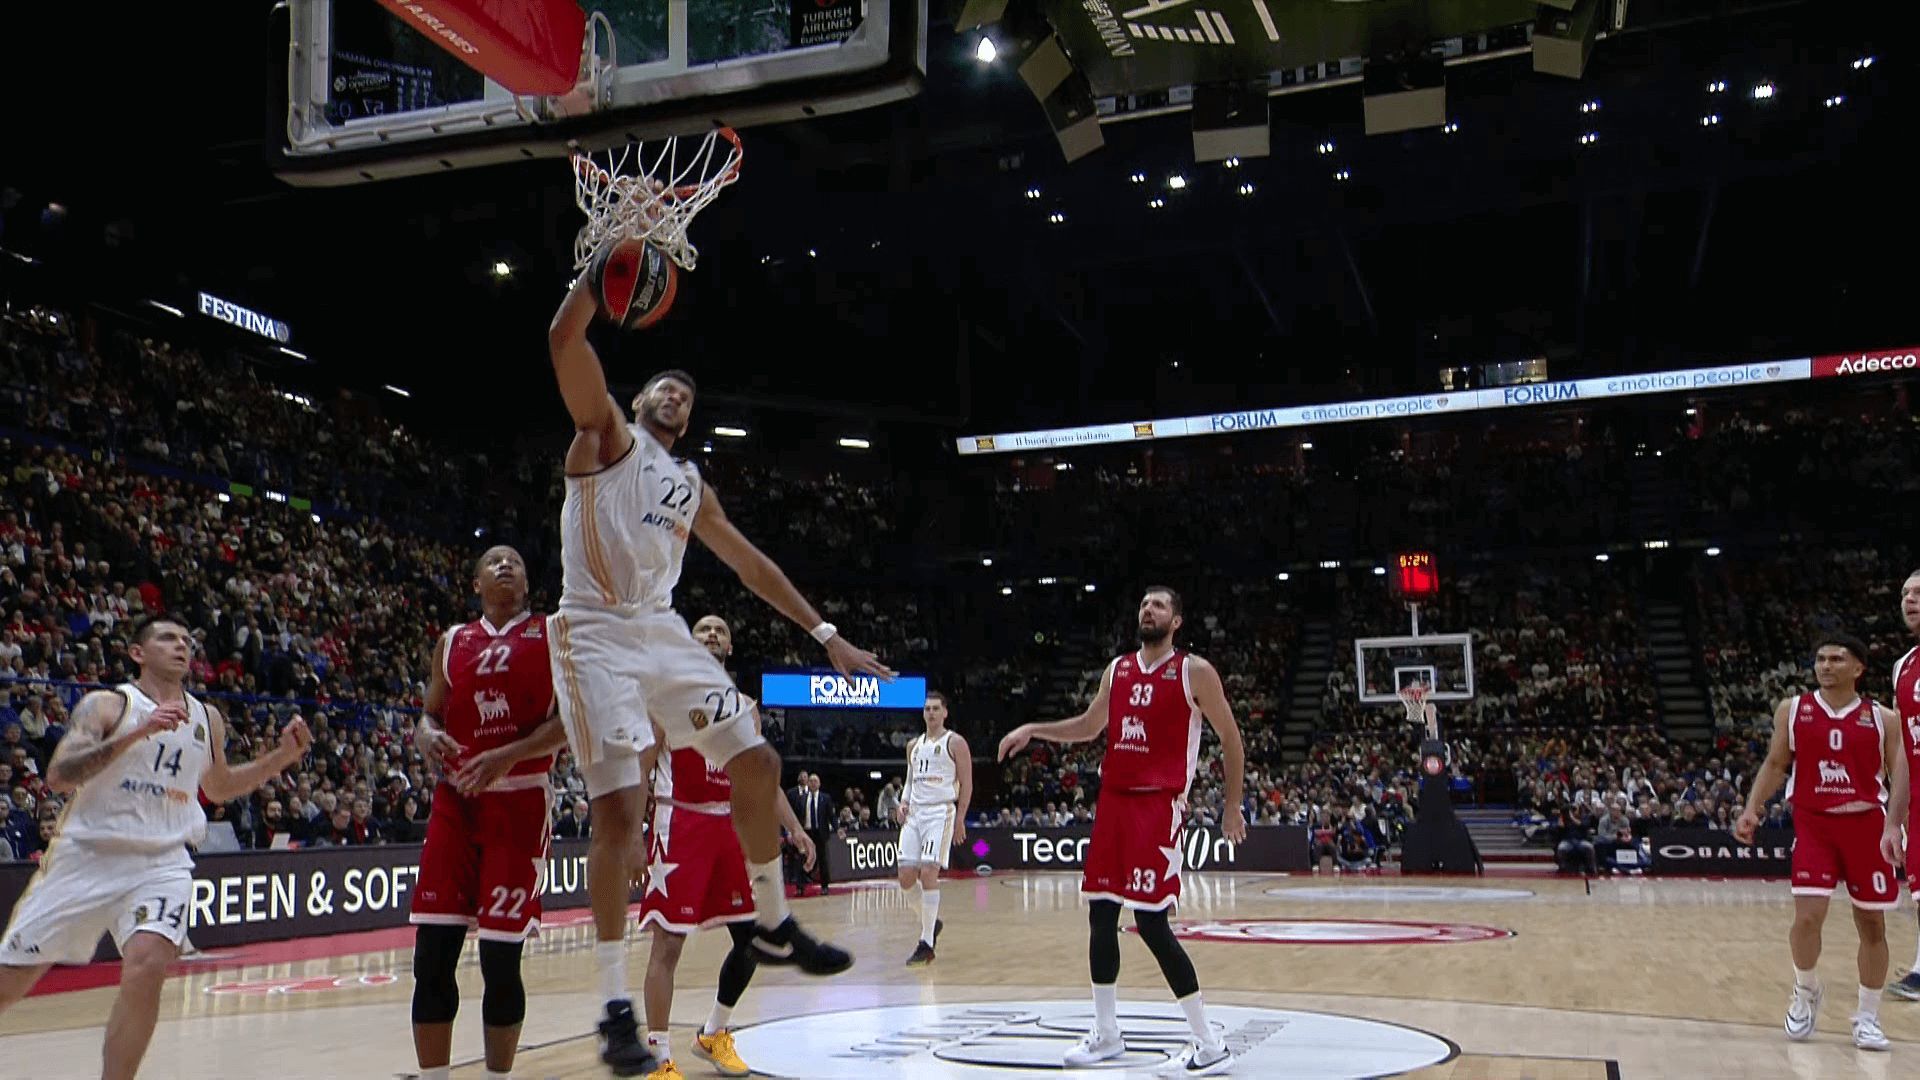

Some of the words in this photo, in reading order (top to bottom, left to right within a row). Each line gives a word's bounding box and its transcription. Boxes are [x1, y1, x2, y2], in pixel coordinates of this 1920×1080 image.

[802, 6, 852, 24] TURKISH
[802, 18, 853, 35] AIRLINES
[200, 292, 277, 340] FESTINA
[1835, 353, 1917, 376] Adecco
[1504, 383, 1579, 404] FORUM
[1693, 366, 1762, 387] people
[1212, 411, 1277, 431] FORUM
[1375, 396, 1433, 416] people
[660, 477, 692, 516] 22
[475, 644, 512, 675] 22
[811, 675, 879, 697] FORUM
[1129, 683, 1154, 707] 33
[1829, 729, 1842, 751] 0
[154, 743, 182, 777] 14
[919, 759, 929, 773] 11
[1815, 785, 1856, 795] plenitude
[924, 840, 935, 855] 11
[1699, 846, 1787, 859] OAKLE
[1132, 867, 1157, 893] 33
[1872, 871, 1887, 895] 0
[188, 872, 296, 928] REEN
[307, 871, 334, 917] &
[488, 885, 527, 919] 22
[157, 897, 185, 929] 14
